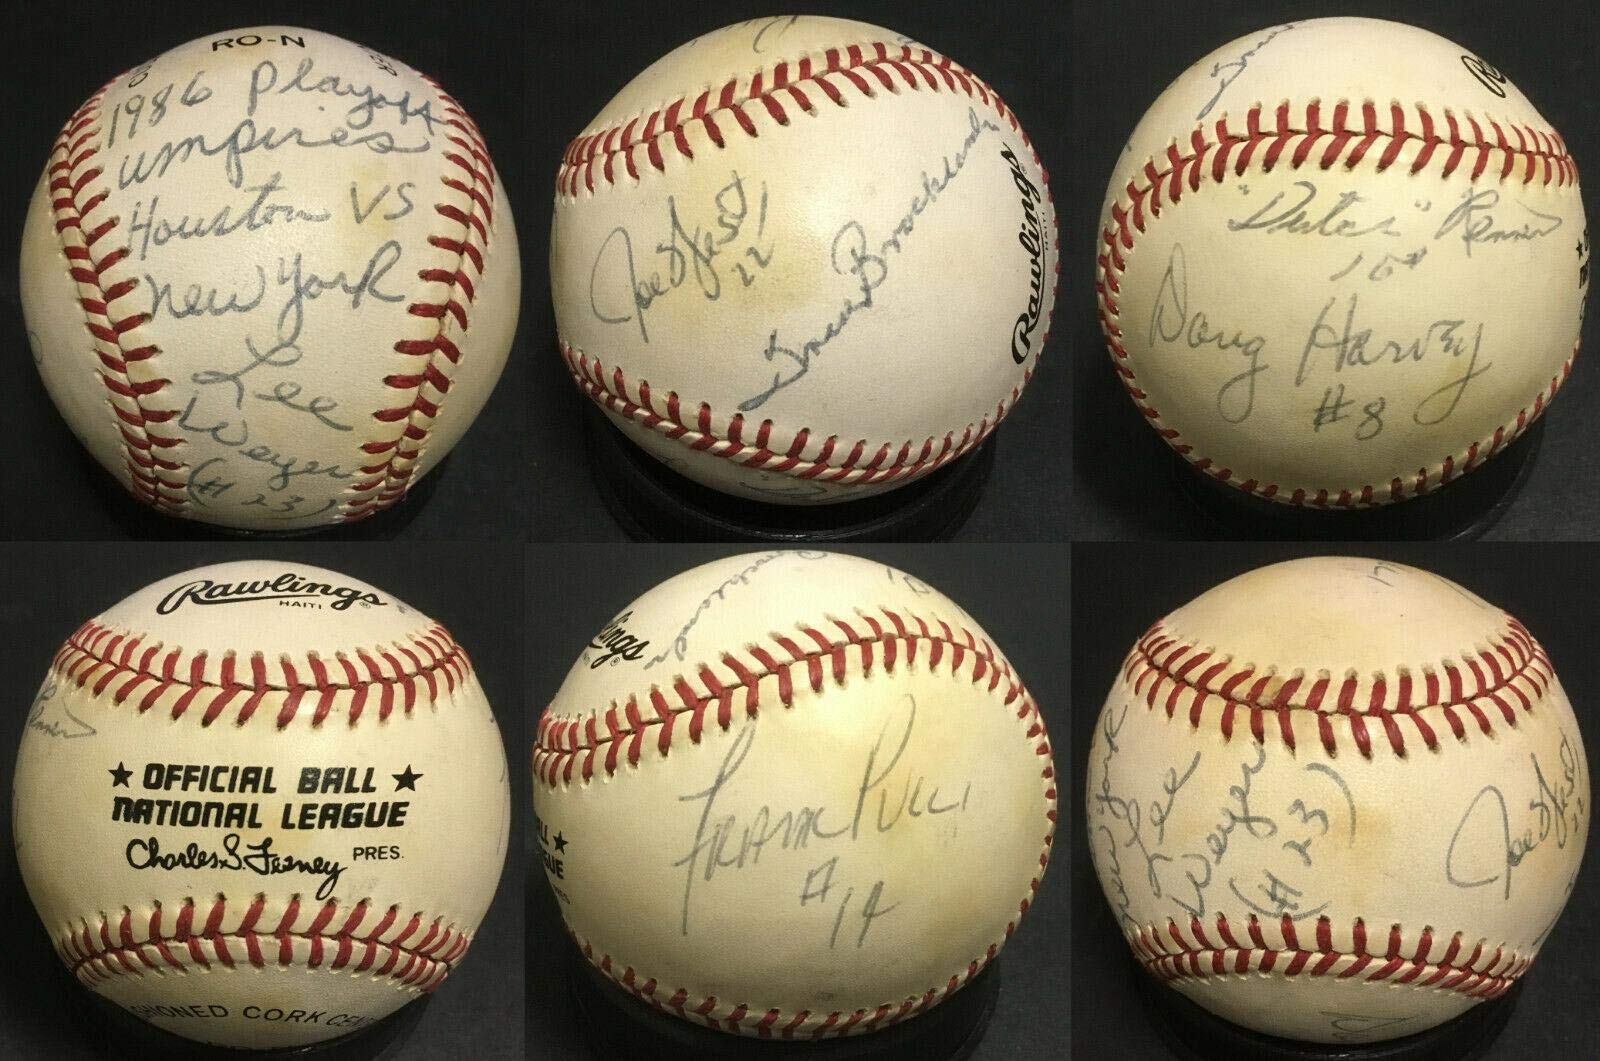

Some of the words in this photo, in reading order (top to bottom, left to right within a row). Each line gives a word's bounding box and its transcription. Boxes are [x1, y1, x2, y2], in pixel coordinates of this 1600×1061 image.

[211, 34, 306, 52] RO-N
[107, 69, 213, 149] 1986
[128, 172, 331, 260] Houston
[1000, 140, 1042, 365] Rawlings
[191, 334, 354, 432] Lee
[1313, 384, 1386, 441] #8
[156, 573, 388, 616] Rawlings
[278, 600, 322, 610] HAITI
[143, 763, 277, 794] OFFICIAL
[298, 766, 377, 794] BALL
[112, 797, 263, 829] NATIONAL
[281, 801, 410, 829] LEAGUE
[353, 846, 405, 861] PRES.
[242, 1005, 327, 1024] CORK
